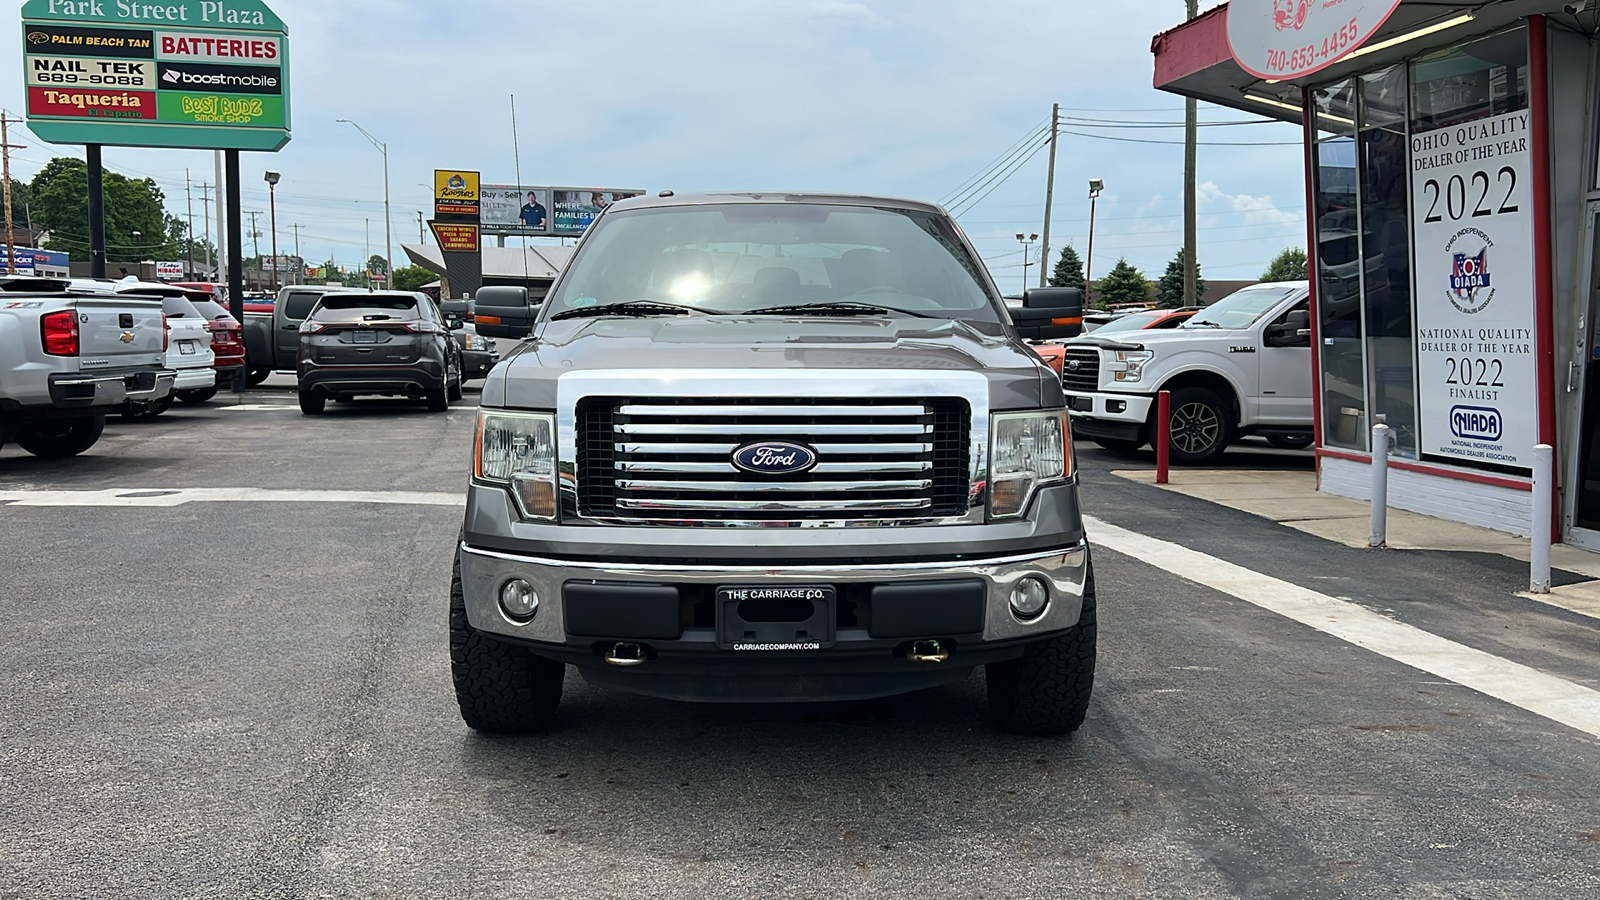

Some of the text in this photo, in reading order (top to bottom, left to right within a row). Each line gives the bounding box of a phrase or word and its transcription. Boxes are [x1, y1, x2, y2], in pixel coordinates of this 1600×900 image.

[48, 0, 265, 25] Park Street Plaza
[51, 35, 150, 48] PALM BEACH TAN
[162, 36, 277, 59] BATTERIES
[1266, 17, 1358, 71] 740-653-4455
[34, 59, 144, 75] NAIL TEK
[37, 73, 144, 86] 689-9088
[182, 72, 277, 87] boostmobile
[44, 91, 141, 109] Taqueria
[221, 98, 263, 117] BUDZ
[88, 108, 99, 116] El
[194, 114, 251, 123] SMOKE SHOP
[1412, 114, 1528, 153] OHIO QUALITY
[1414, 138, 1527, 171] DEALER OF THE YEAR
[481, 191, 497, 199] Buy
[1424, 166, 1518, 223] 2022
[554, 211, 589, 219] FAMILIES
[1444, 227, 1494, 252] OHIO INDEPENDENT
[1454, 275, 1484, 288] OIADA
[1420, 328, 1532, 341] NATIONAL QUALITY
[1421, 342, 1530, 354] DEALER OF THE YEAR
[1445, 357, 1504, 387] 2022
[1450, 388, 1498, 400] FINALIST
[1454, 412, 1497, 434] NIADA
[1451, 440, 1503, 451] NATIONAL INDEPENDENT
[751, 447, 797, 466] Ford
[1440, 447, 1517, 462] AUTOMOBILE DEALERS ASSOCIATION
[727, 589, 825, 600] THE CARRIAGE CO.
[733, 643, 820, 651] CARRIAGECOMPANY.COM
